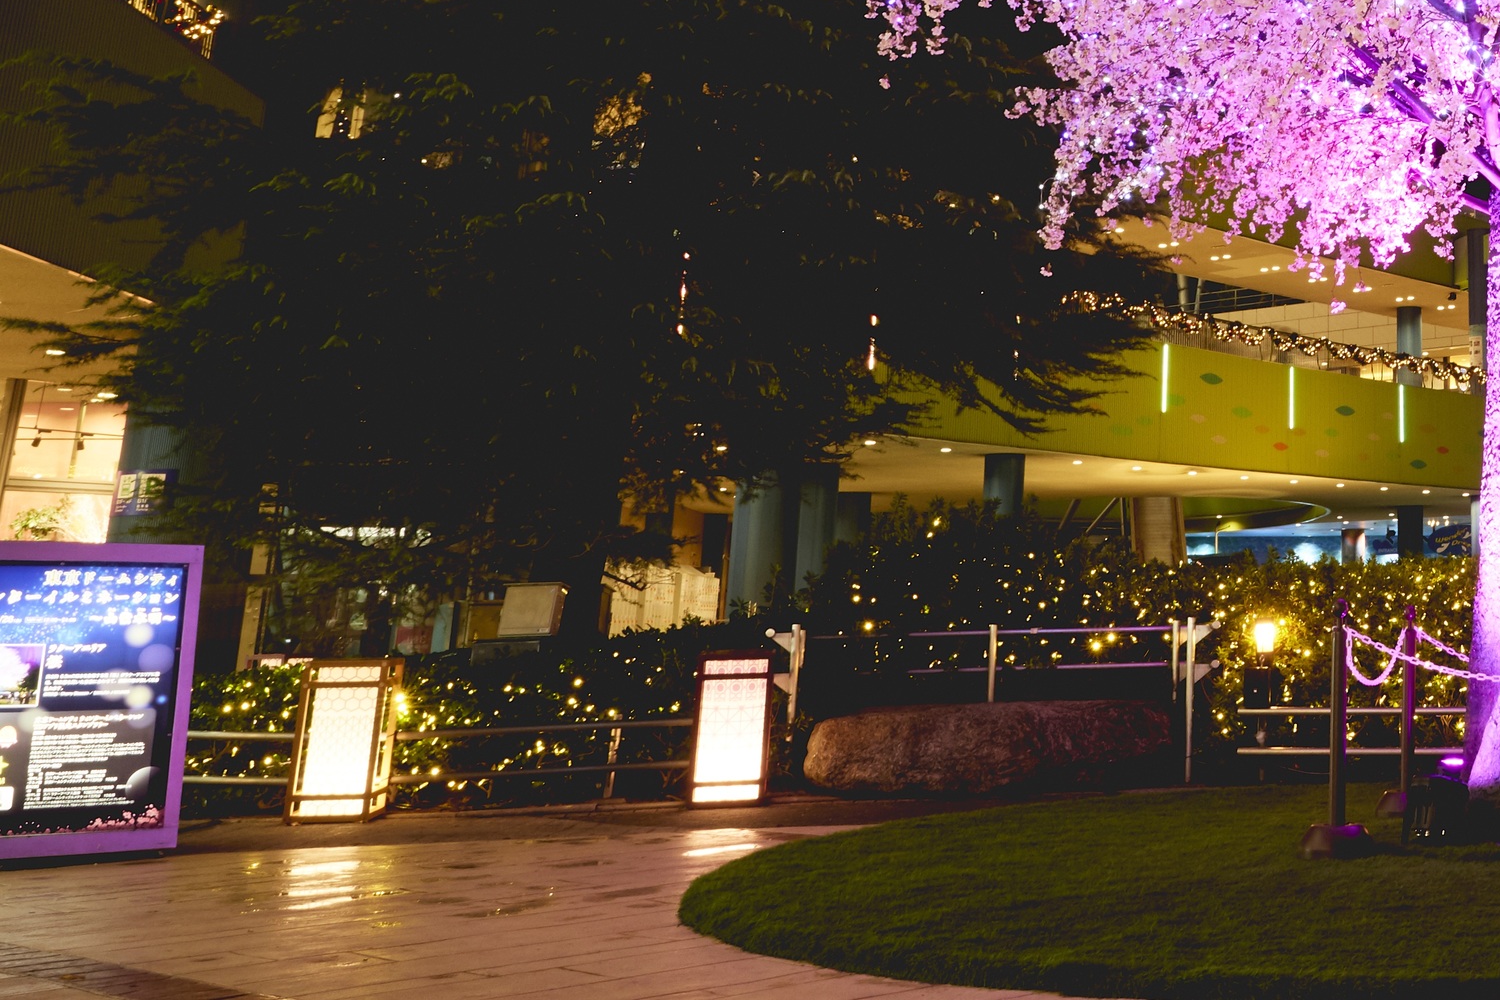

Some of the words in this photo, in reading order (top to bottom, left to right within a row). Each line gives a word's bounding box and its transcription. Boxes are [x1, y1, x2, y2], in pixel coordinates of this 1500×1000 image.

[44, 569, 178, 586] 東京ドームシティ
